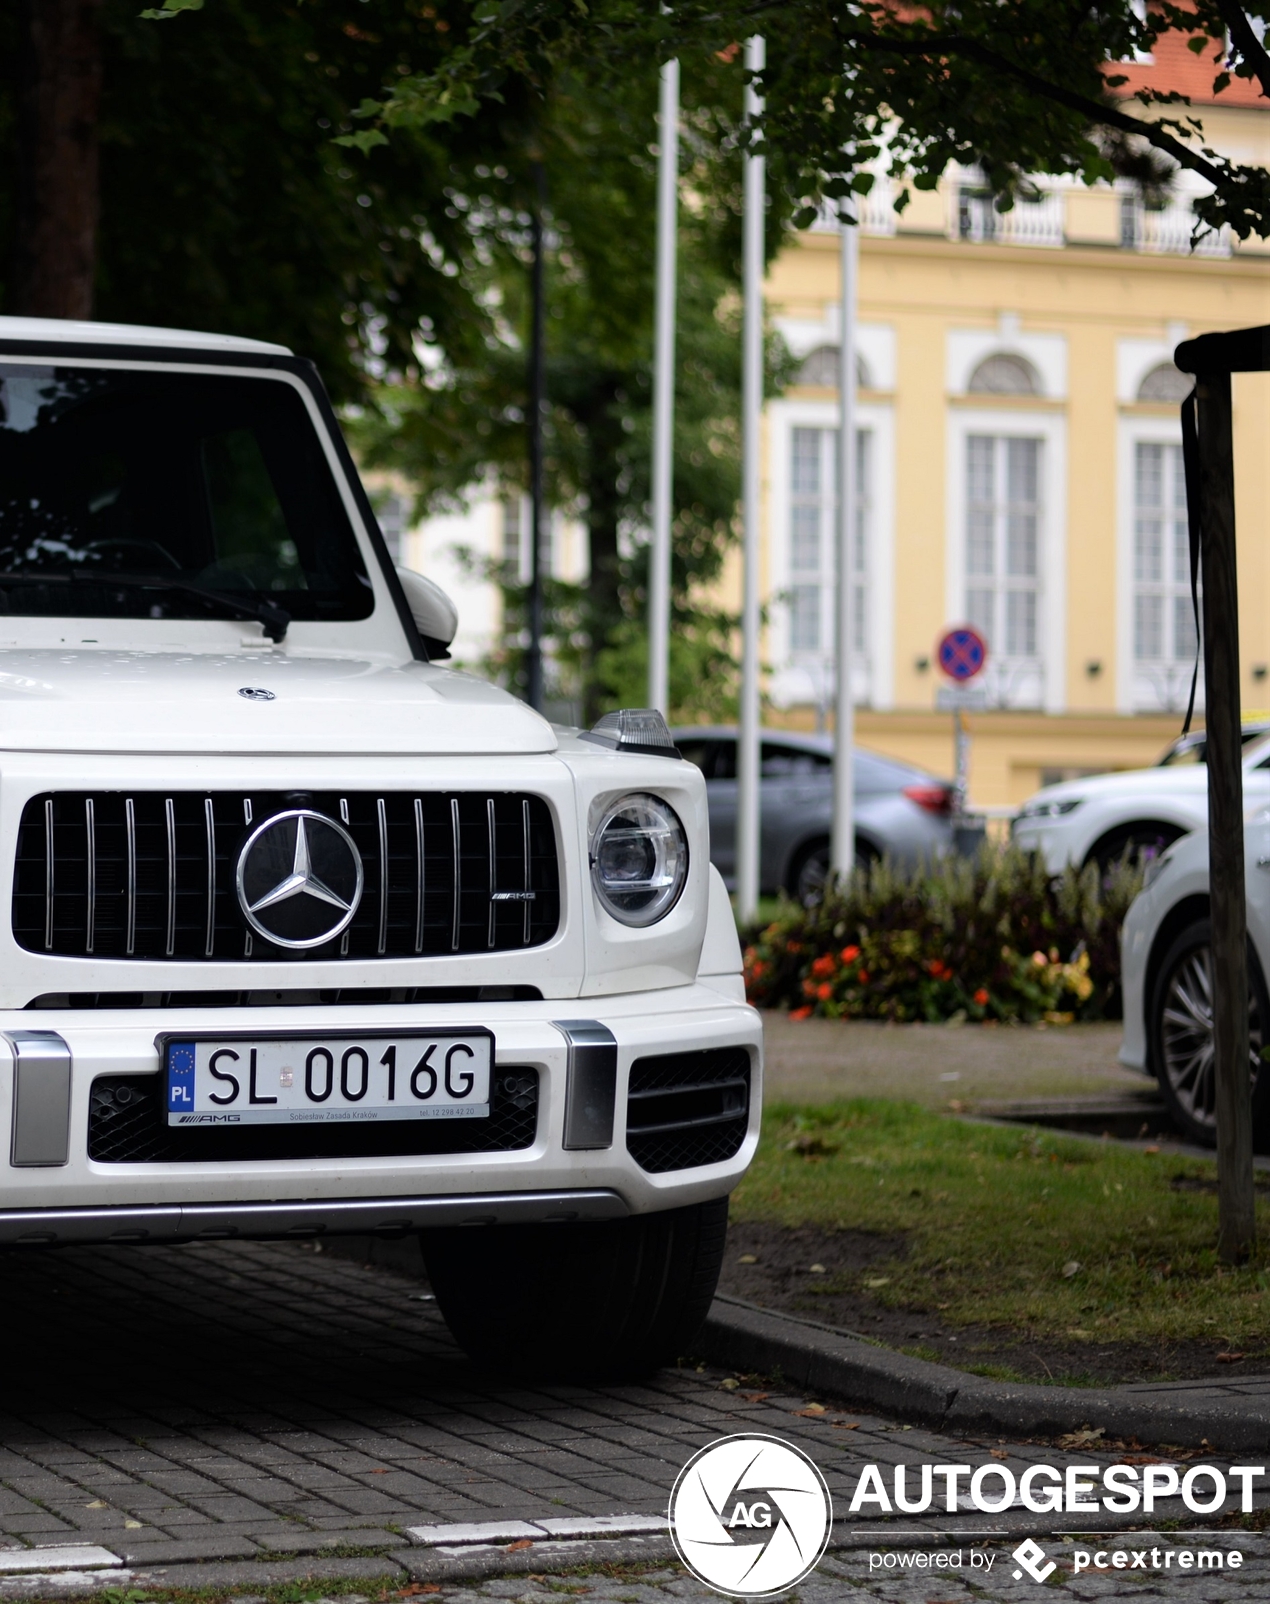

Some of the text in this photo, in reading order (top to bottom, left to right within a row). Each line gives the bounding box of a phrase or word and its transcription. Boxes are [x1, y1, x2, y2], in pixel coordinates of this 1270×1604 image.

[208, 1043, 475, 1105] SL 0016G
[171, 1086, 191, 1102] PL
[289, 1110, 378, 1121] Sobiesław Zasada Kraków
[419, 1109, 429, 1117] tel.
[432, 1108, 440, 1116] 12
[441, 1108, 454, 1116] 298
[455, 1108, 464, 1116] 42
